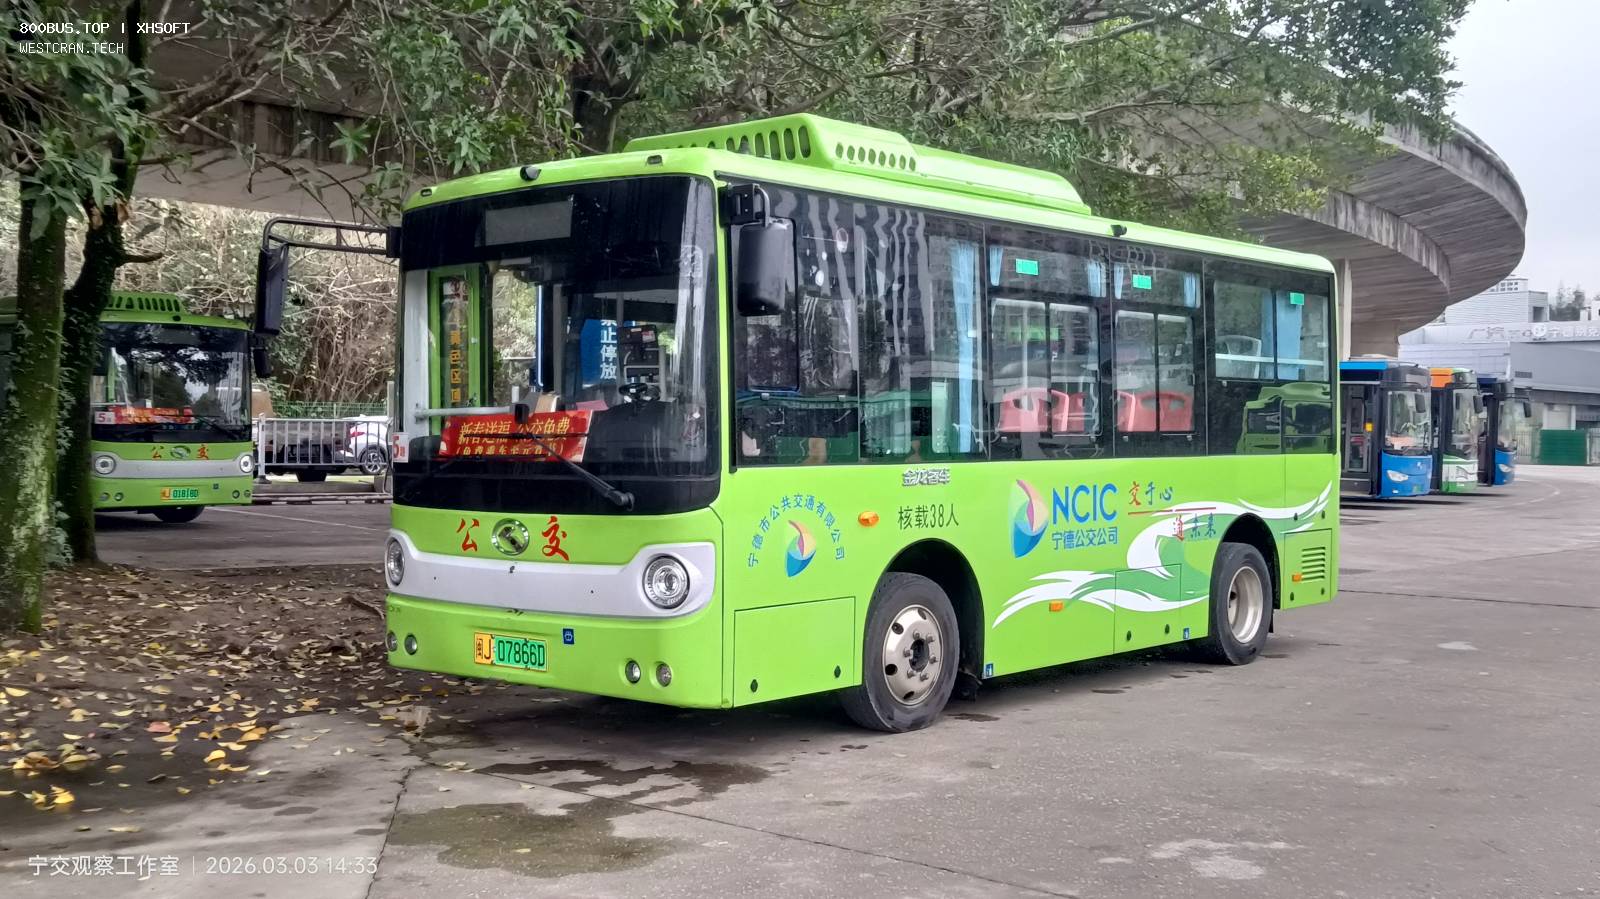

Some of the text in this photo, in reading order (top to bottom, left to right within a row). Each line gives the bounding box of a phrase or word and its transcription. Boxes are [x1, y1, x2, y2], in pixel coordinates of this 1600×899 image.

[898, 503, 959, 530] 核载38人
[1053, 483, 1117, 524] NCIC
[456, 515, 570, 561] 公 交
[748, 494, 845, 567] 宁德市公共交通有限公司
[1052, 526, 1118, 550] 宁德公交公司
